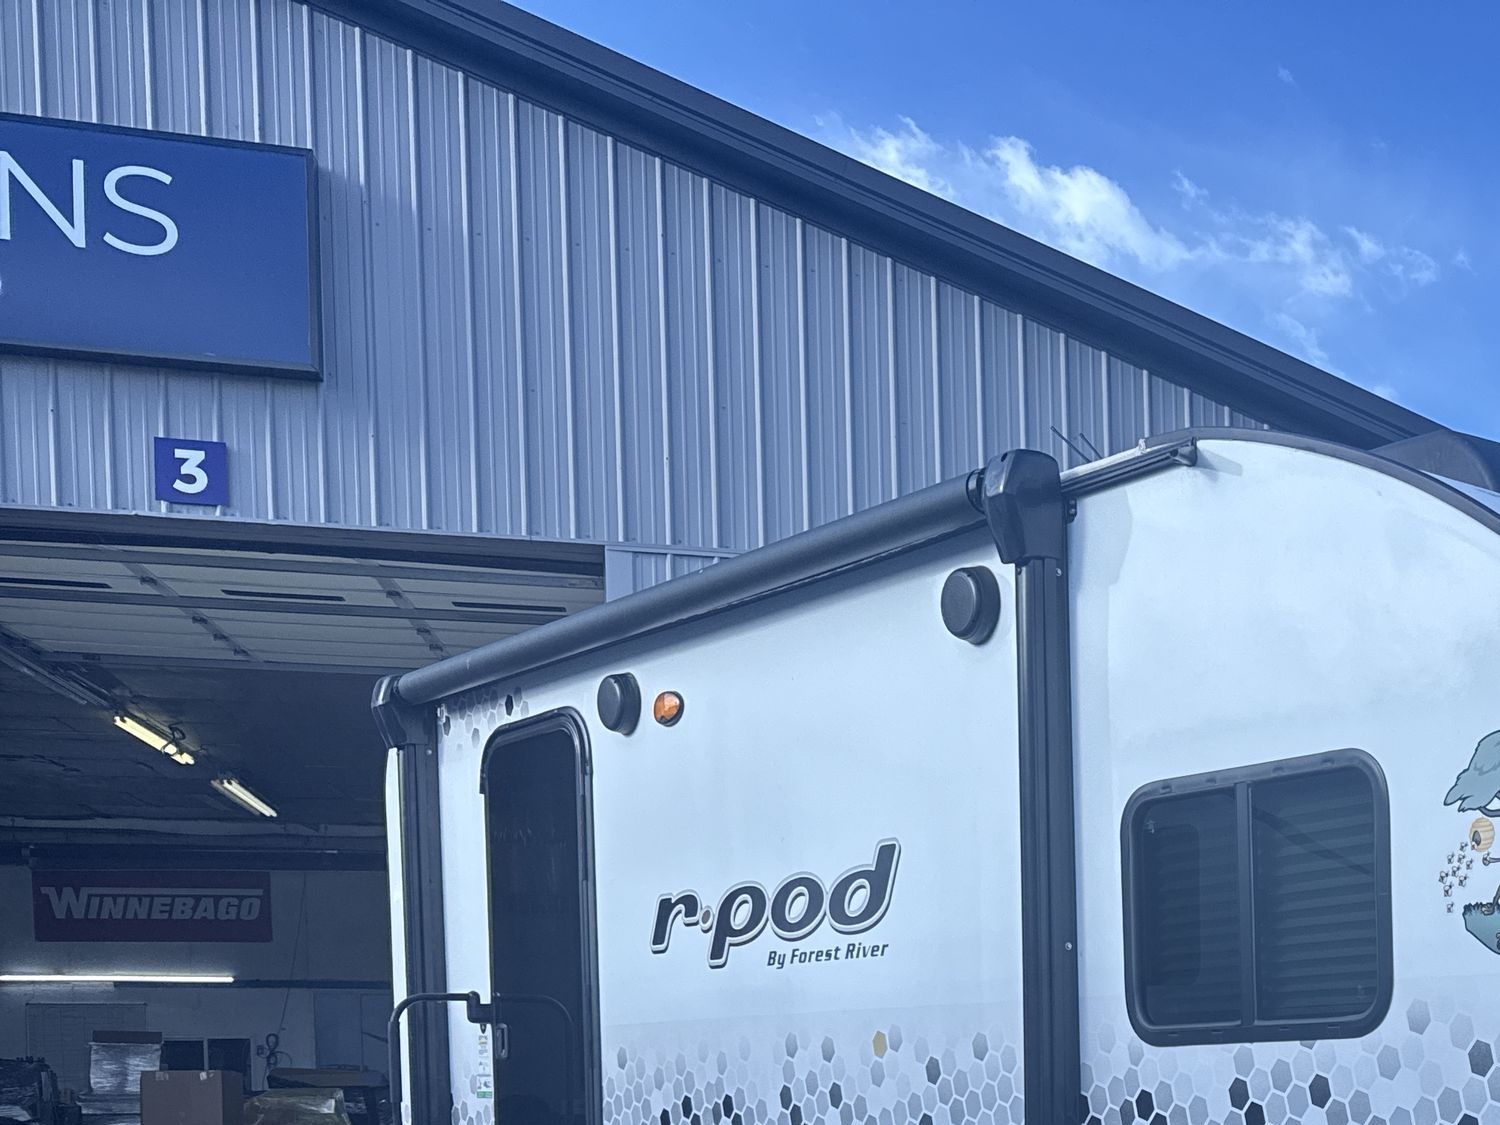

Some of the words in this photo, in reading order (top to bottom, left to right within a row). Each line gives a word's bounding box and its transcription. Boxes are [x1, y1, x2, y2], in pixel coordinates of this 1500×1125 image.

[0, 150, 179, 256] NS
[172, 448, 208, 494] 3
[39, 886, 264, 921] WINNEBAGO
[767, 950, 786, 970] By
[790, 945, 841, 965] Forest
[845, 942, 889, 960] River
